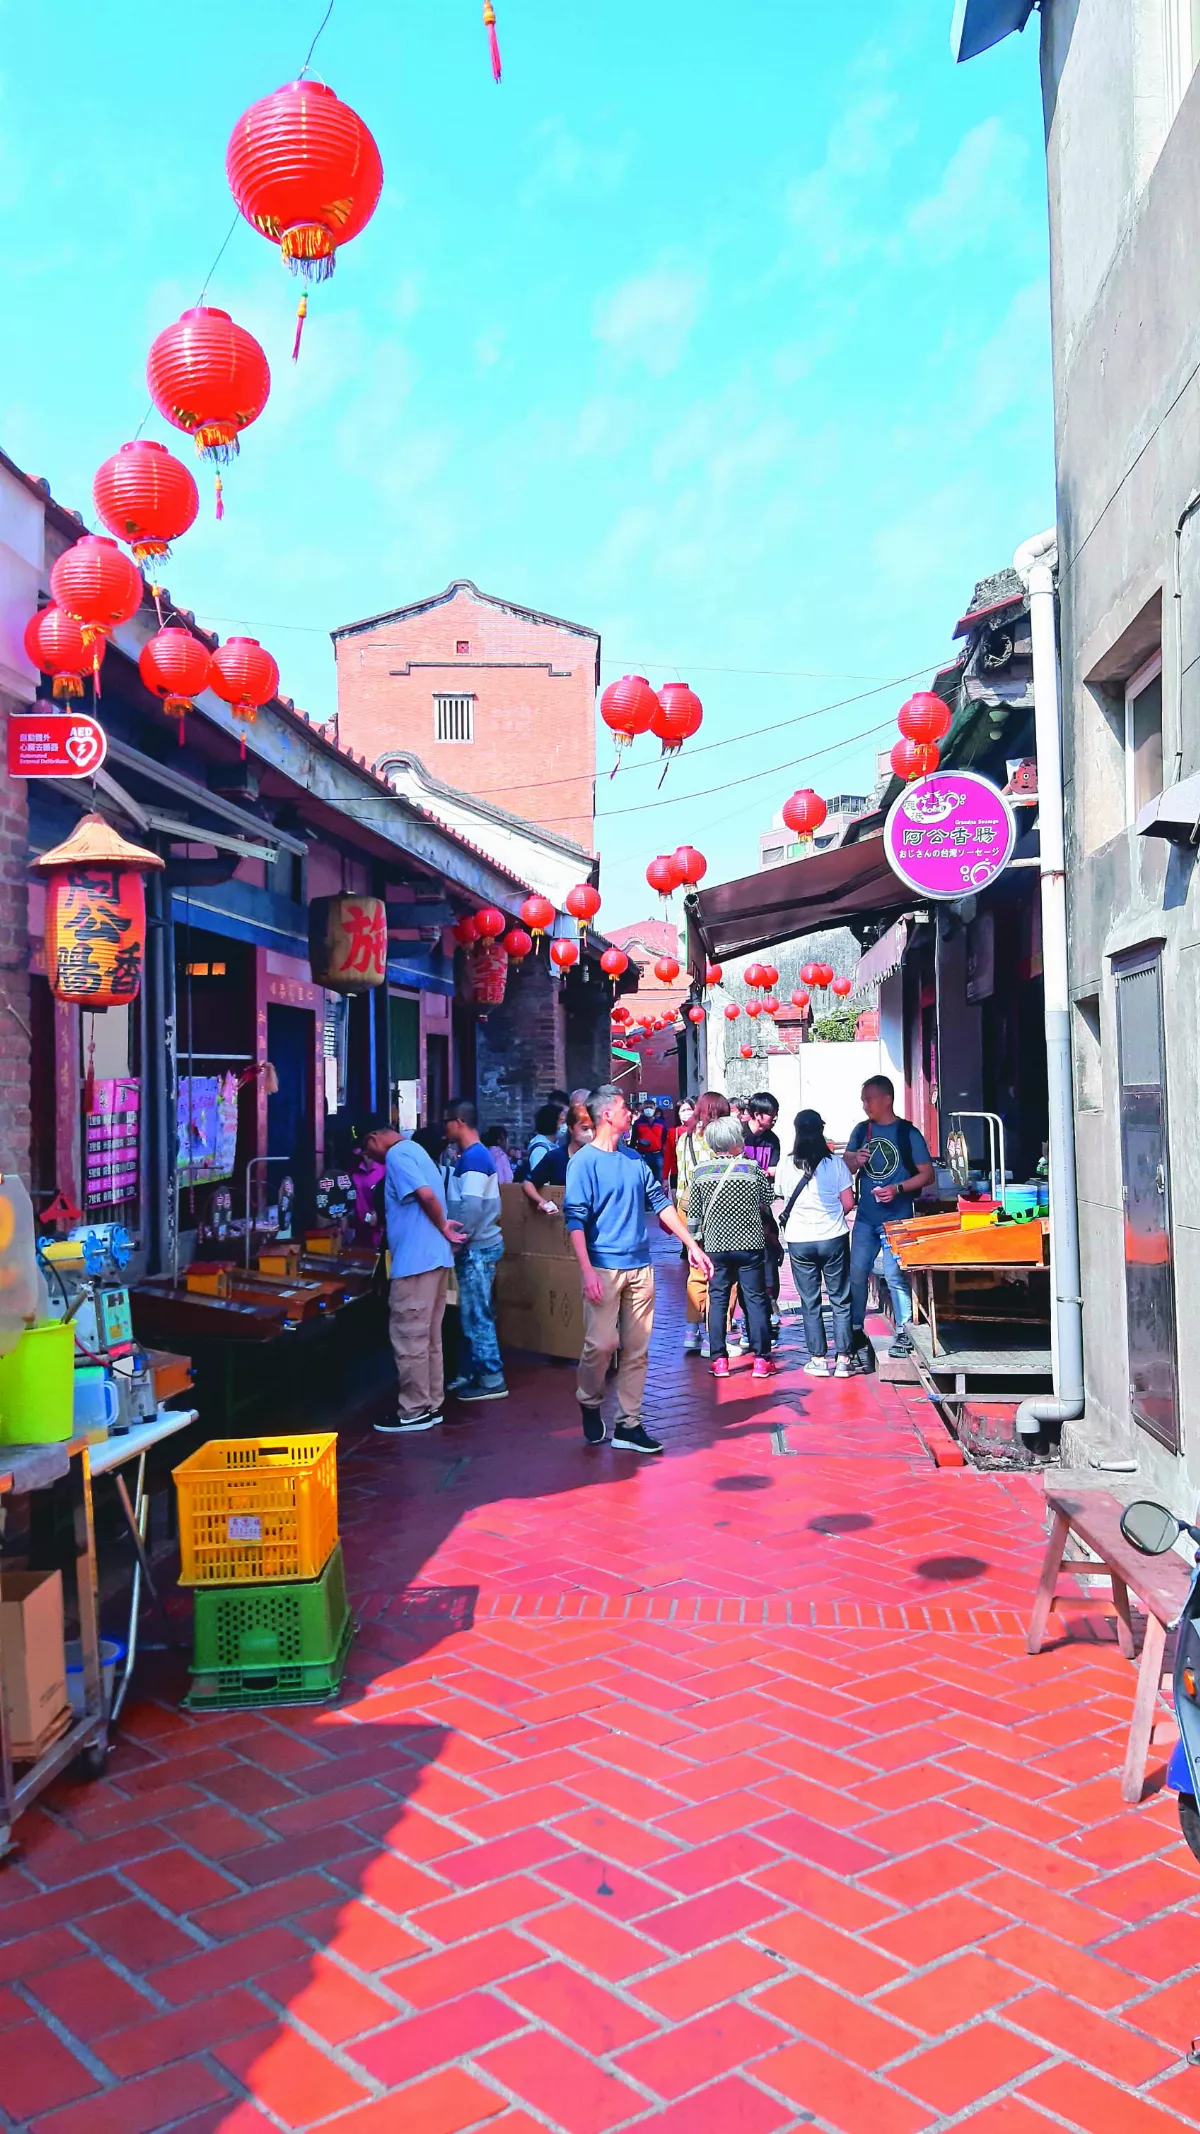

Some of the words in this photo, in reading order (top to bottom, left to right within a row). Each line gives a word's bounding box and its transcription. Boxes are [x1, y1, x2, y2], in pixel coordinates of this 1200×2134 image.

[69, 727, 93, 736] AED
[903, 826, 997, 846] 阿公香腸
